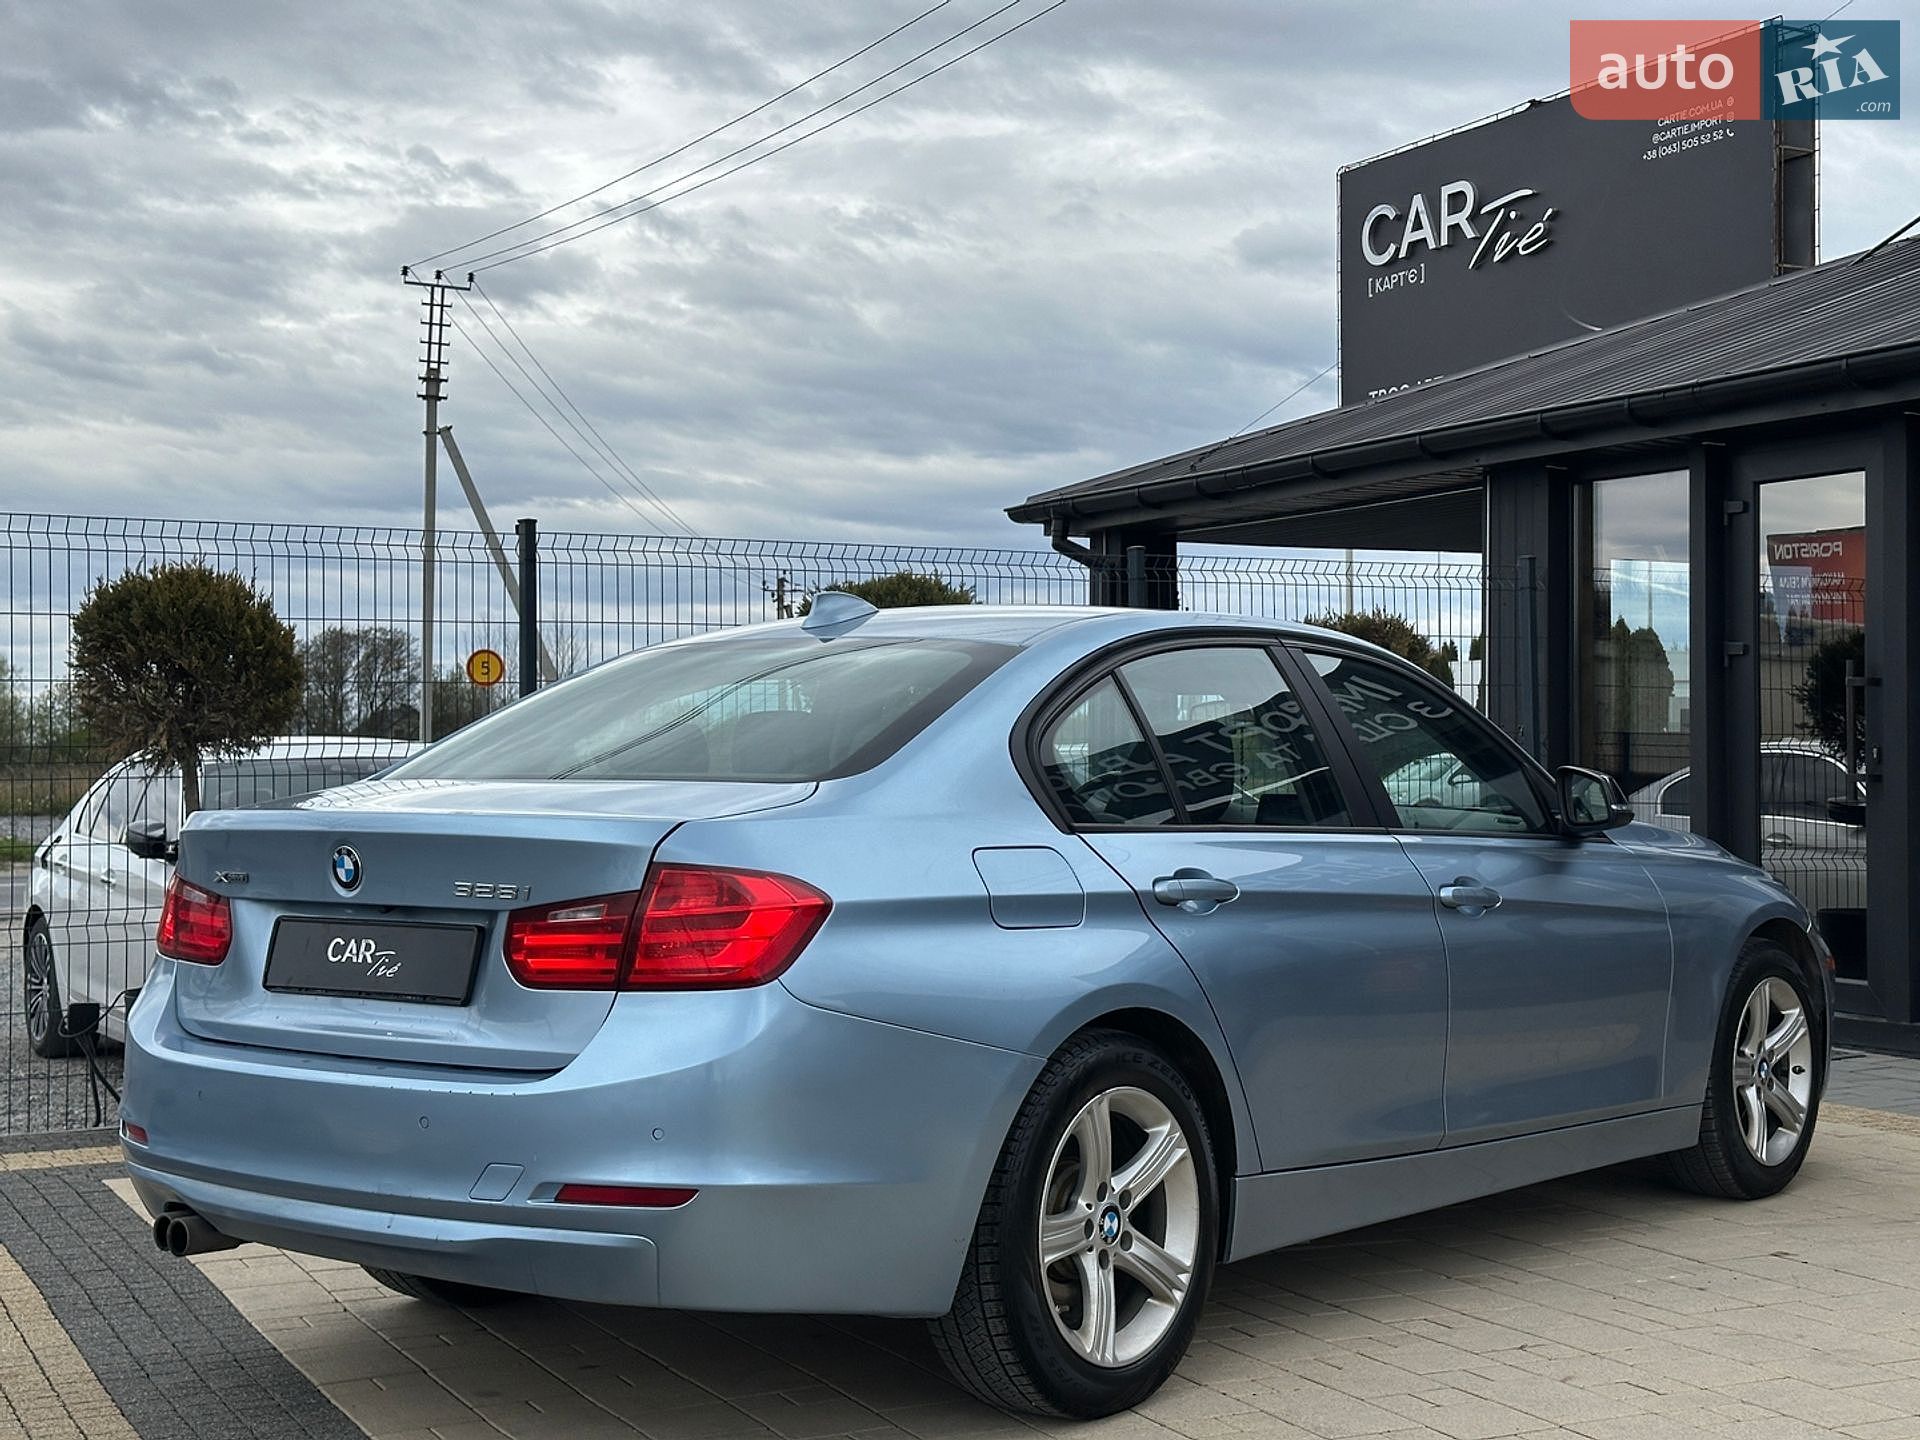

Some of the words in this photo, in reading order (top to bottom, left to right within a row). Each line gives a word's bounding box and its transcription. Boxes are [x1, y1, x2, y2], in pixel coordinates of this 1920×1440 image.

[1643, 149, 1657, 160] +38
[1682, 136, 1699, 150] 505
[1700, 133, 1711, 145] 52
[1713, 129, 1724, 141] 52
[481, 661, 490, 676] 5
[454, 881, 531, 901] 328i
